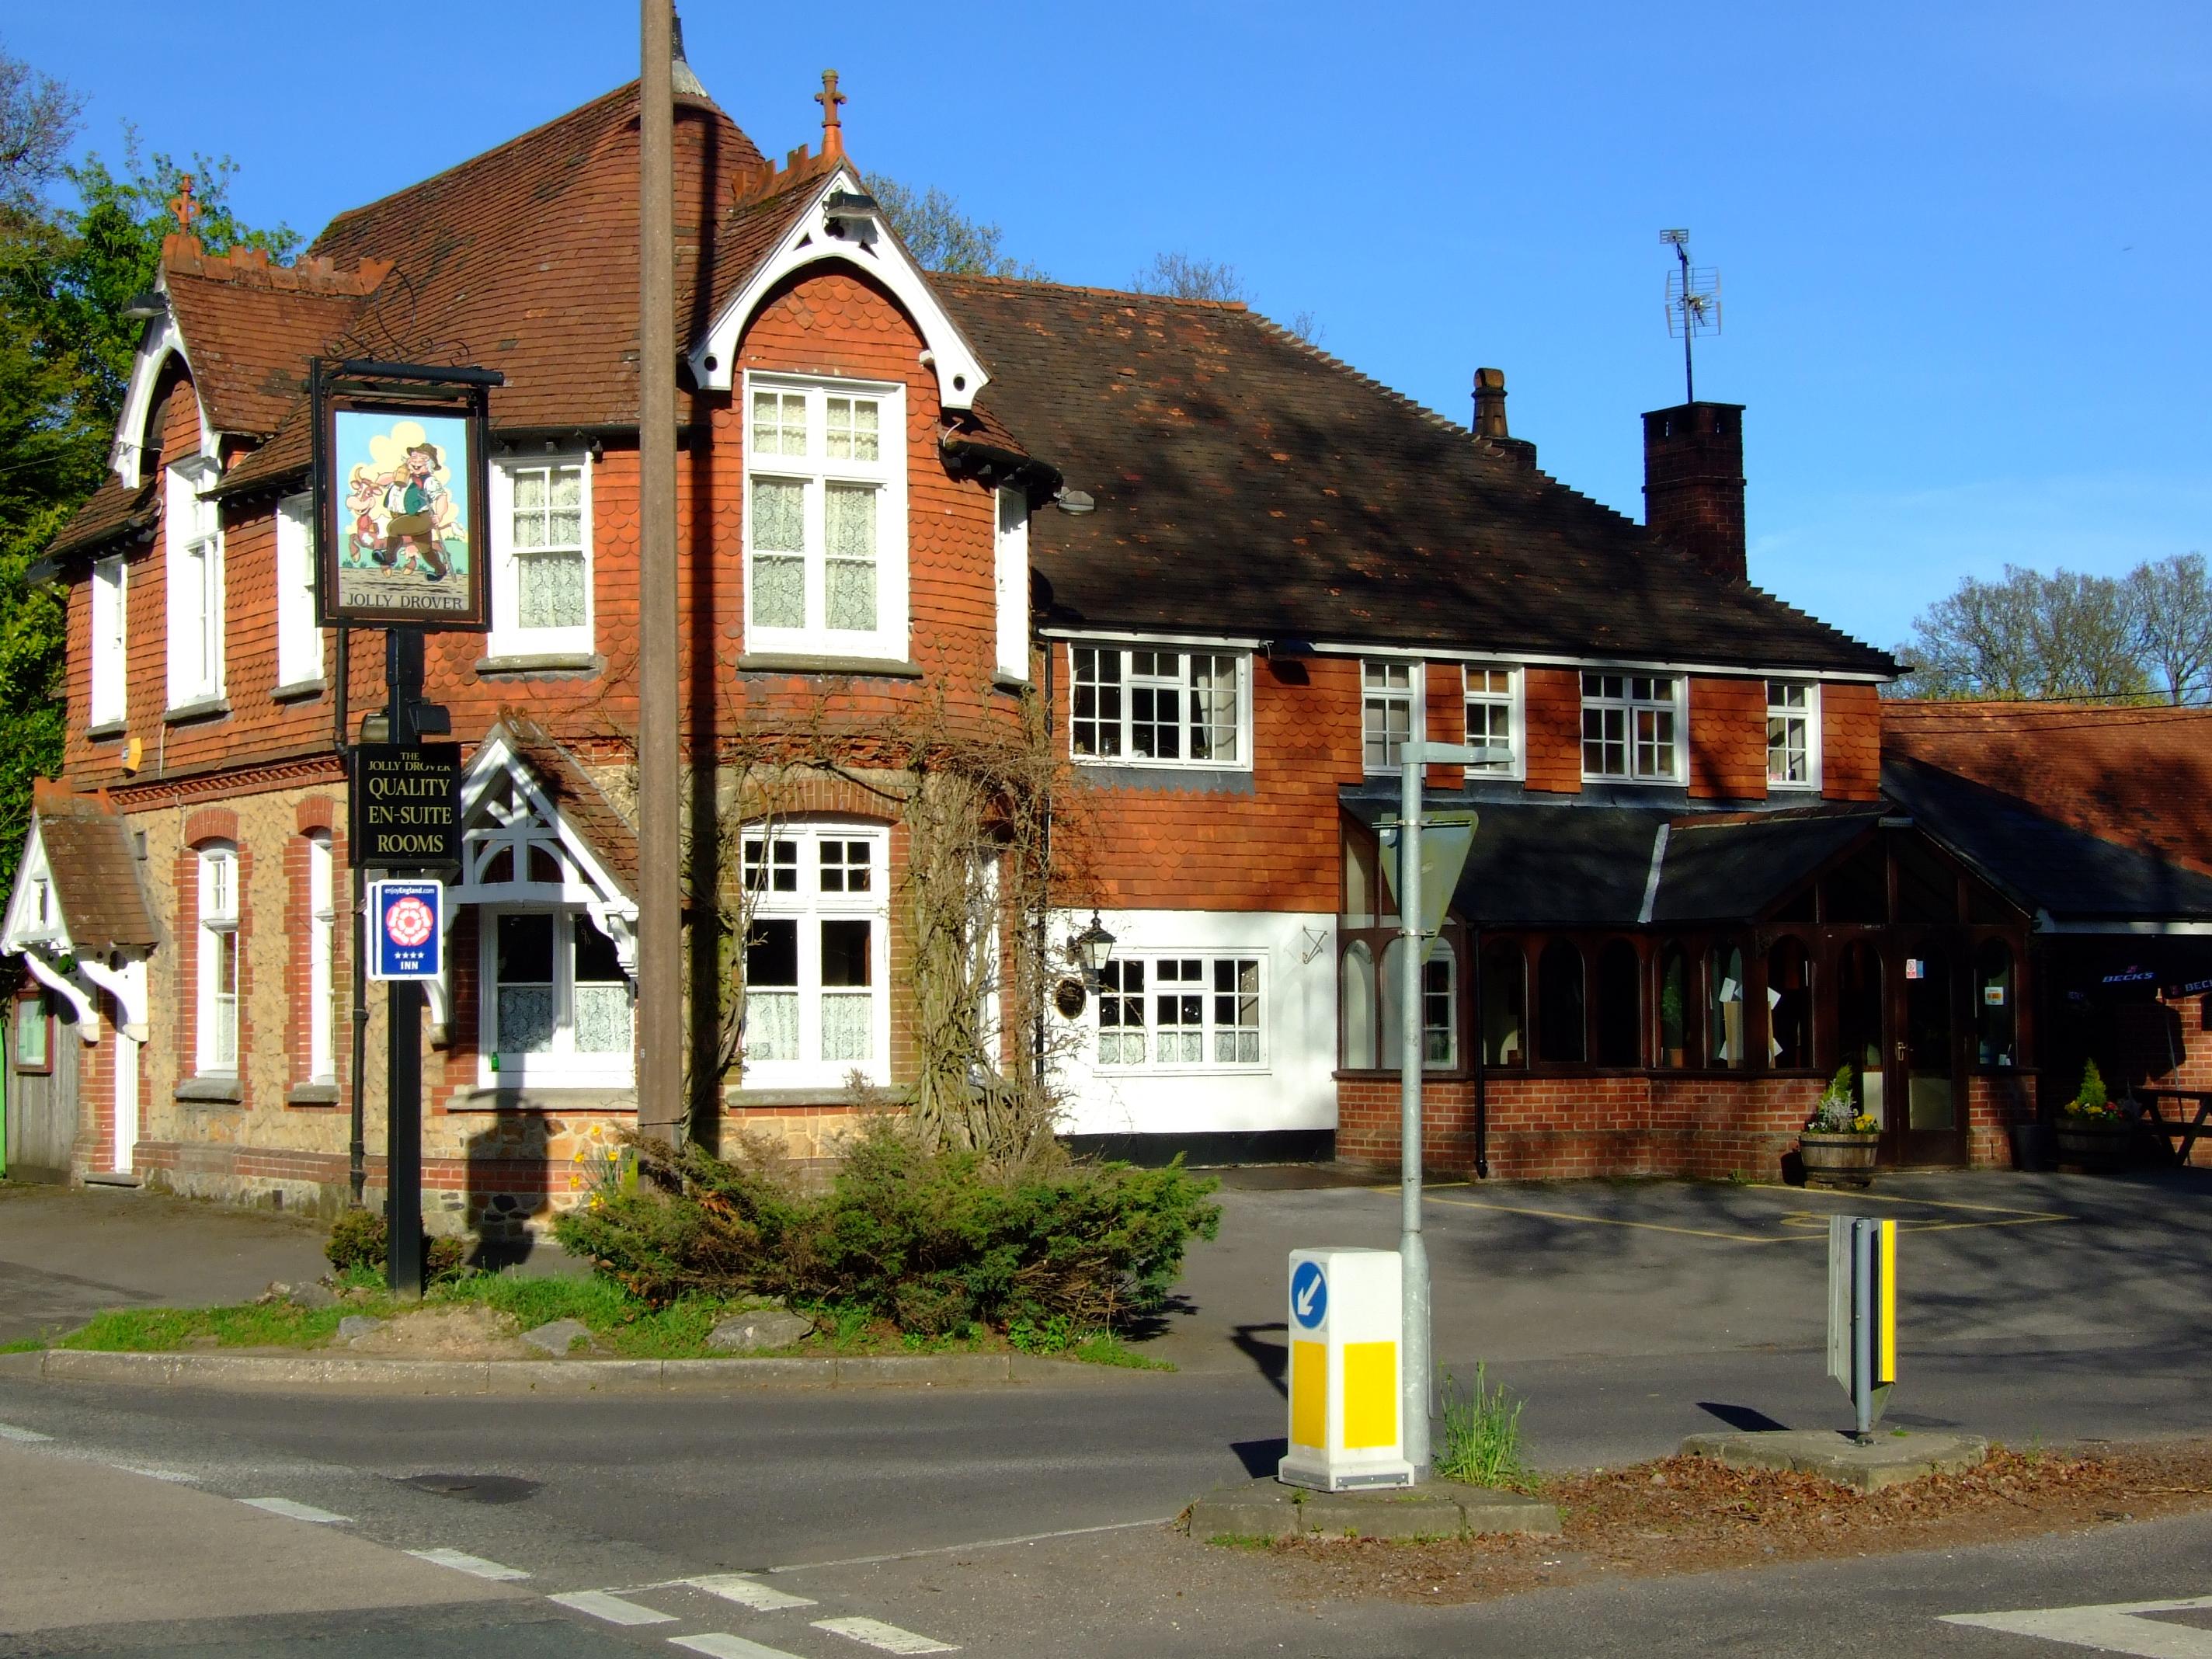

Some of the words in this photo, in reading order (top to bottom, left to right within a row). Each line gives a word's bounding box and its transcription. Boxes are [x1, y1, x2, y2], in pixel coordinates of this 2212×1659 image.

[346, 593, 393, 607] JOLLY
[401, 596, 463, 610] DROVER
[400, 752, 420, 760] THE
[368, 760, 401, 771] JOLLY
[369, 777, 450, 800] QUALITY
[369, 805, 452, 824] EN-SUITE
[377, 834, 443, 852] ROOMS
[384, 886, 435, 895] enjoyEngland.com
[400, 961, 419, 970] INN
